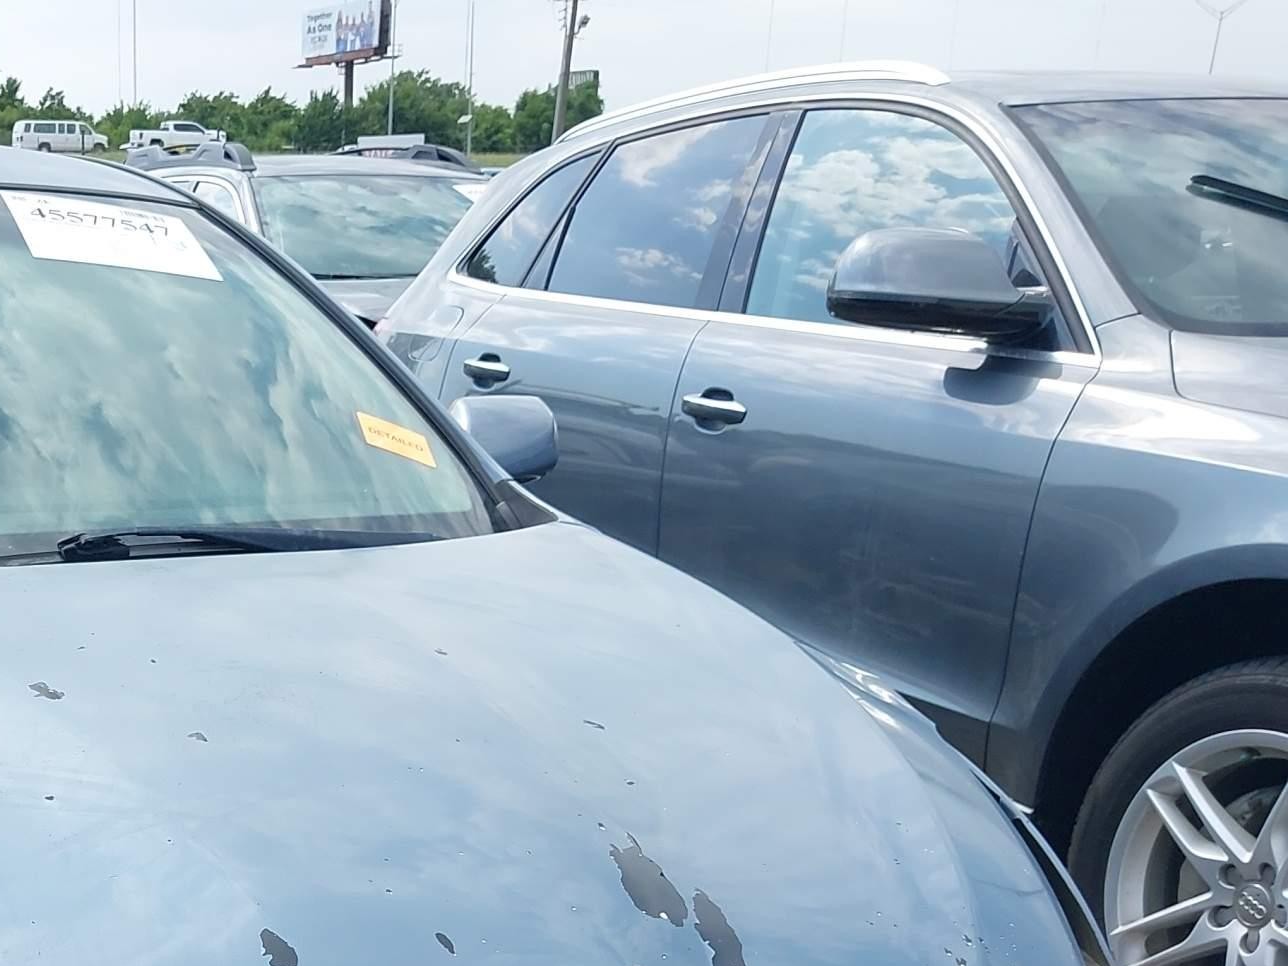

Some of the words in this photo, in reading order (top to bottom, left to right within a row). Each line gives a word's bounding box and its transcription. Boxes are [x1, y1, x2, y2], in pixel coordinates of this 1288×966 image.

[307, 25, 316, 35] As
[317, 23, 332, 33] One
[30, 207, 168, 237] 45577547
